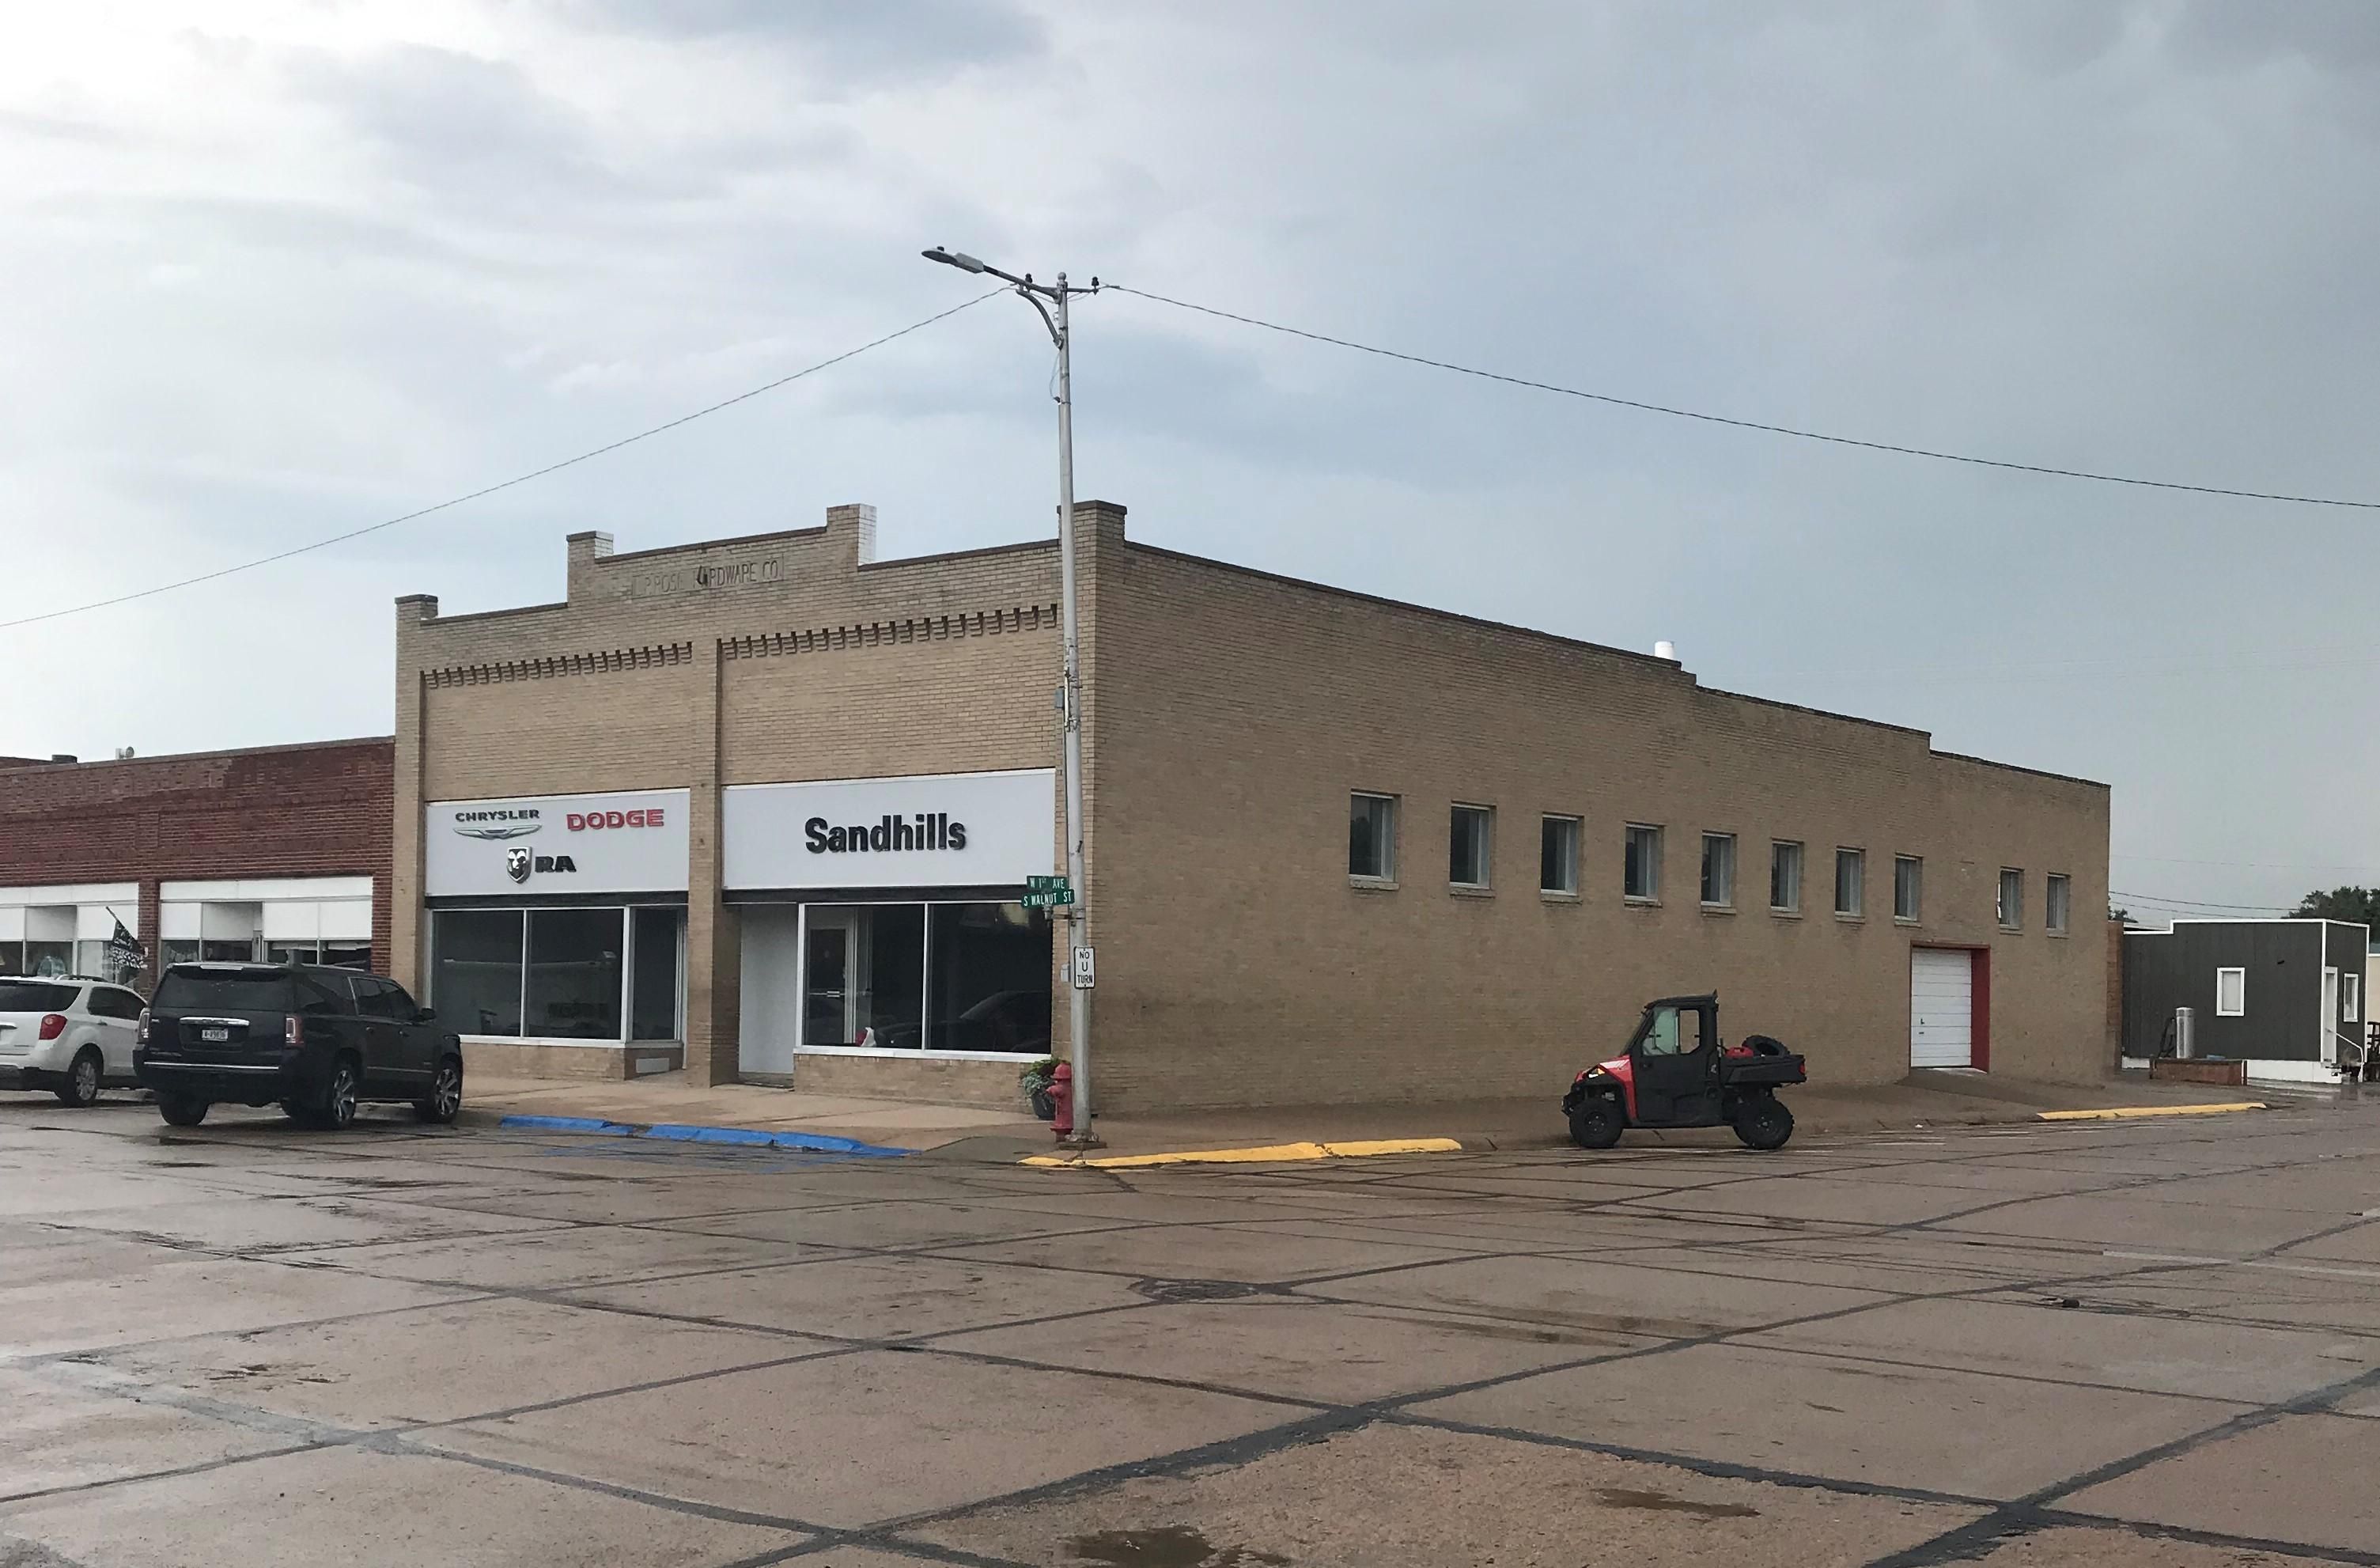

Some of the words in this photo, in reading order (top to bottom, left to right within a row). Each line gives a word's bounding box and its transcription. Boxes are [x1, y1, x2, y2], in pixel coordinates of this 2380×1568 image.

[455, 809, 540, 822] CHRYSLER
[567, 809, 664, 831] DODGE
[804, 812, 967, 854] Sandhills
[535, 855, 577, 873] RA
[1030, 877, 1035, 888] W
[1053, 878, 1065, 889] AVE
[1024, 896, 1028, 907] S
[1031, 892, 1057, 906] WALNUT
[1063, 891, 1072, 903] ST
[1081, 961, 1088, 972] U
[1076, 974, 1093, 983] TURN
